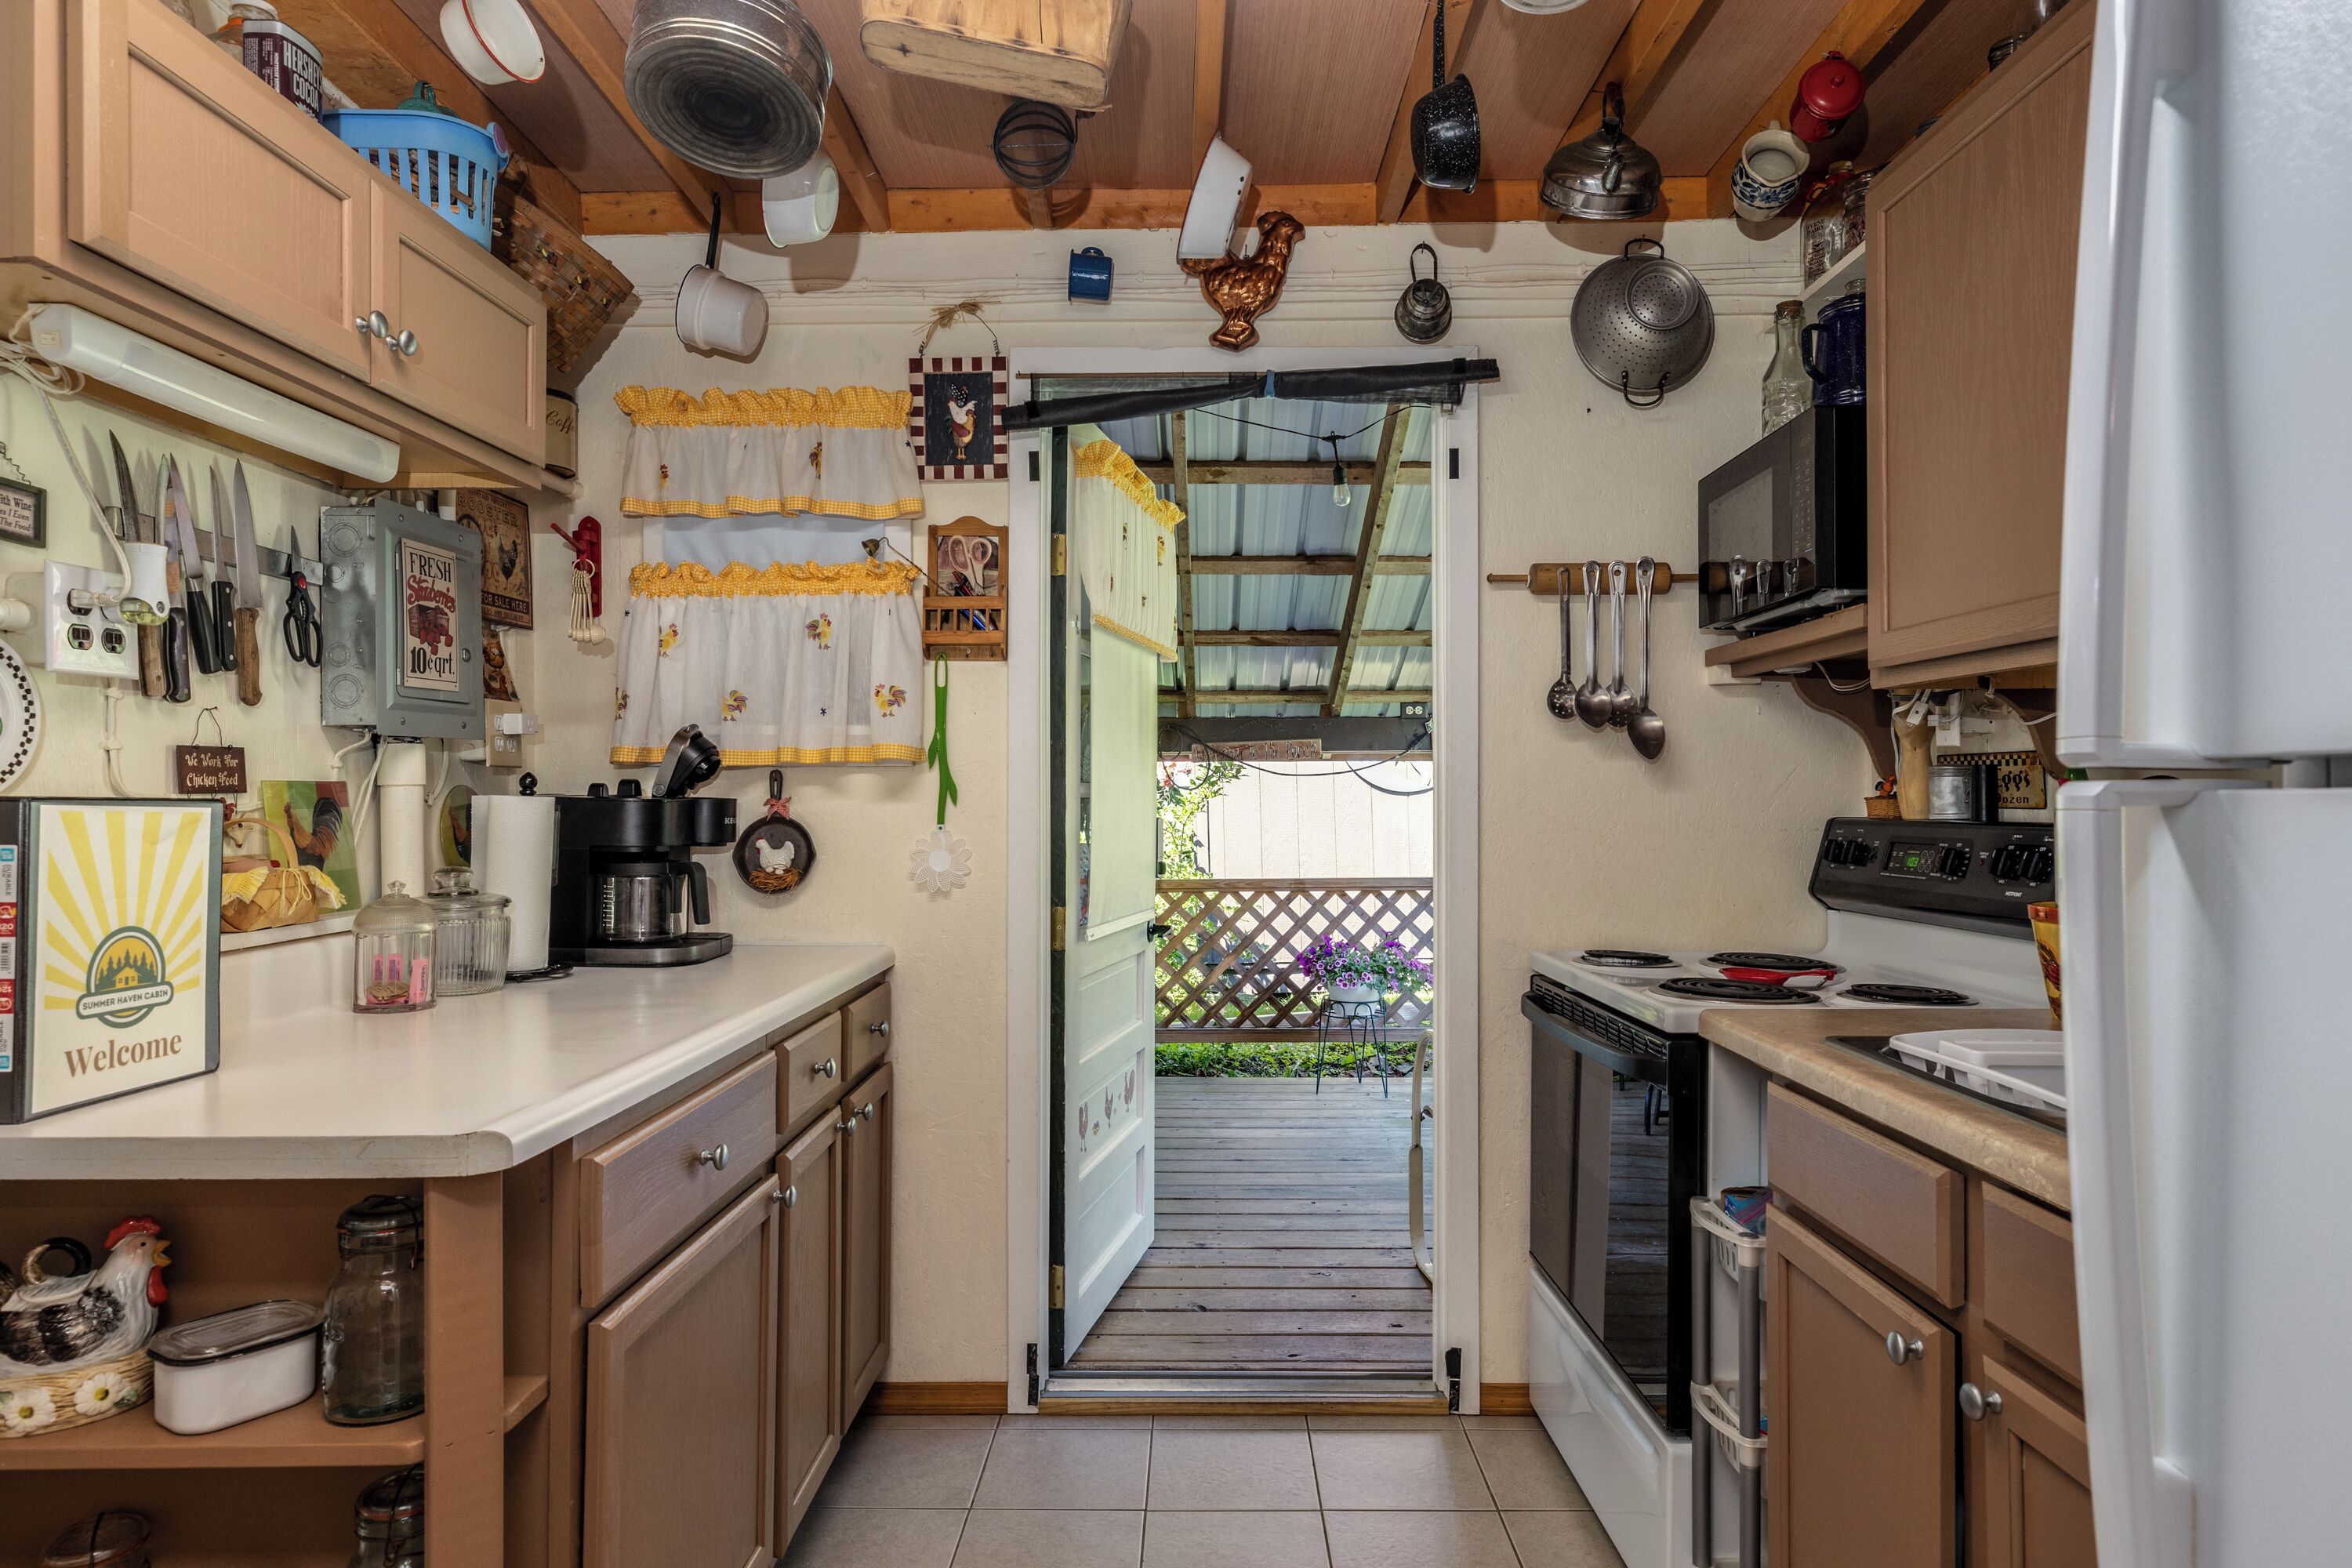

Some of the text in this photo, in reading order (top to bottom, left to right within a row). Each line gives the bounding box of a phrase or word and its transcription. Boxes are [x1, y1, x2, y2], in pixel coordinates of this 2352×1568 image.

[283, 40, 322, 92] HERSHEY
[293, 74, 319, 112] COCOA
[1806, 219, 1825, 230] BYRNE
[1806, 225, 1824, 236] DAIRY
[546, 410, 576, 434] Coffe
[0, 493, 32, 511] ith Wine
[457, 493, 518, 528] ROOSTER
[0, 516, 31, 532] The Food
[13, 510, 30, 521] Even
[409, 552, 452, 583] FRESH
[494, 596, 510, 608] SALE
[511, 600, 528, 612] HERE
[434, 652, 455, 678] qrt.
[1287, 740, 1317, 760] Porch
[185, 753, 238, 768] We Work For
[187, 771, 238, 788] Chicken Feed
[82, 989, 169, 1010] SUMMER HAVEN CABIN
[64, 1034, 182, 1077] Welcome
